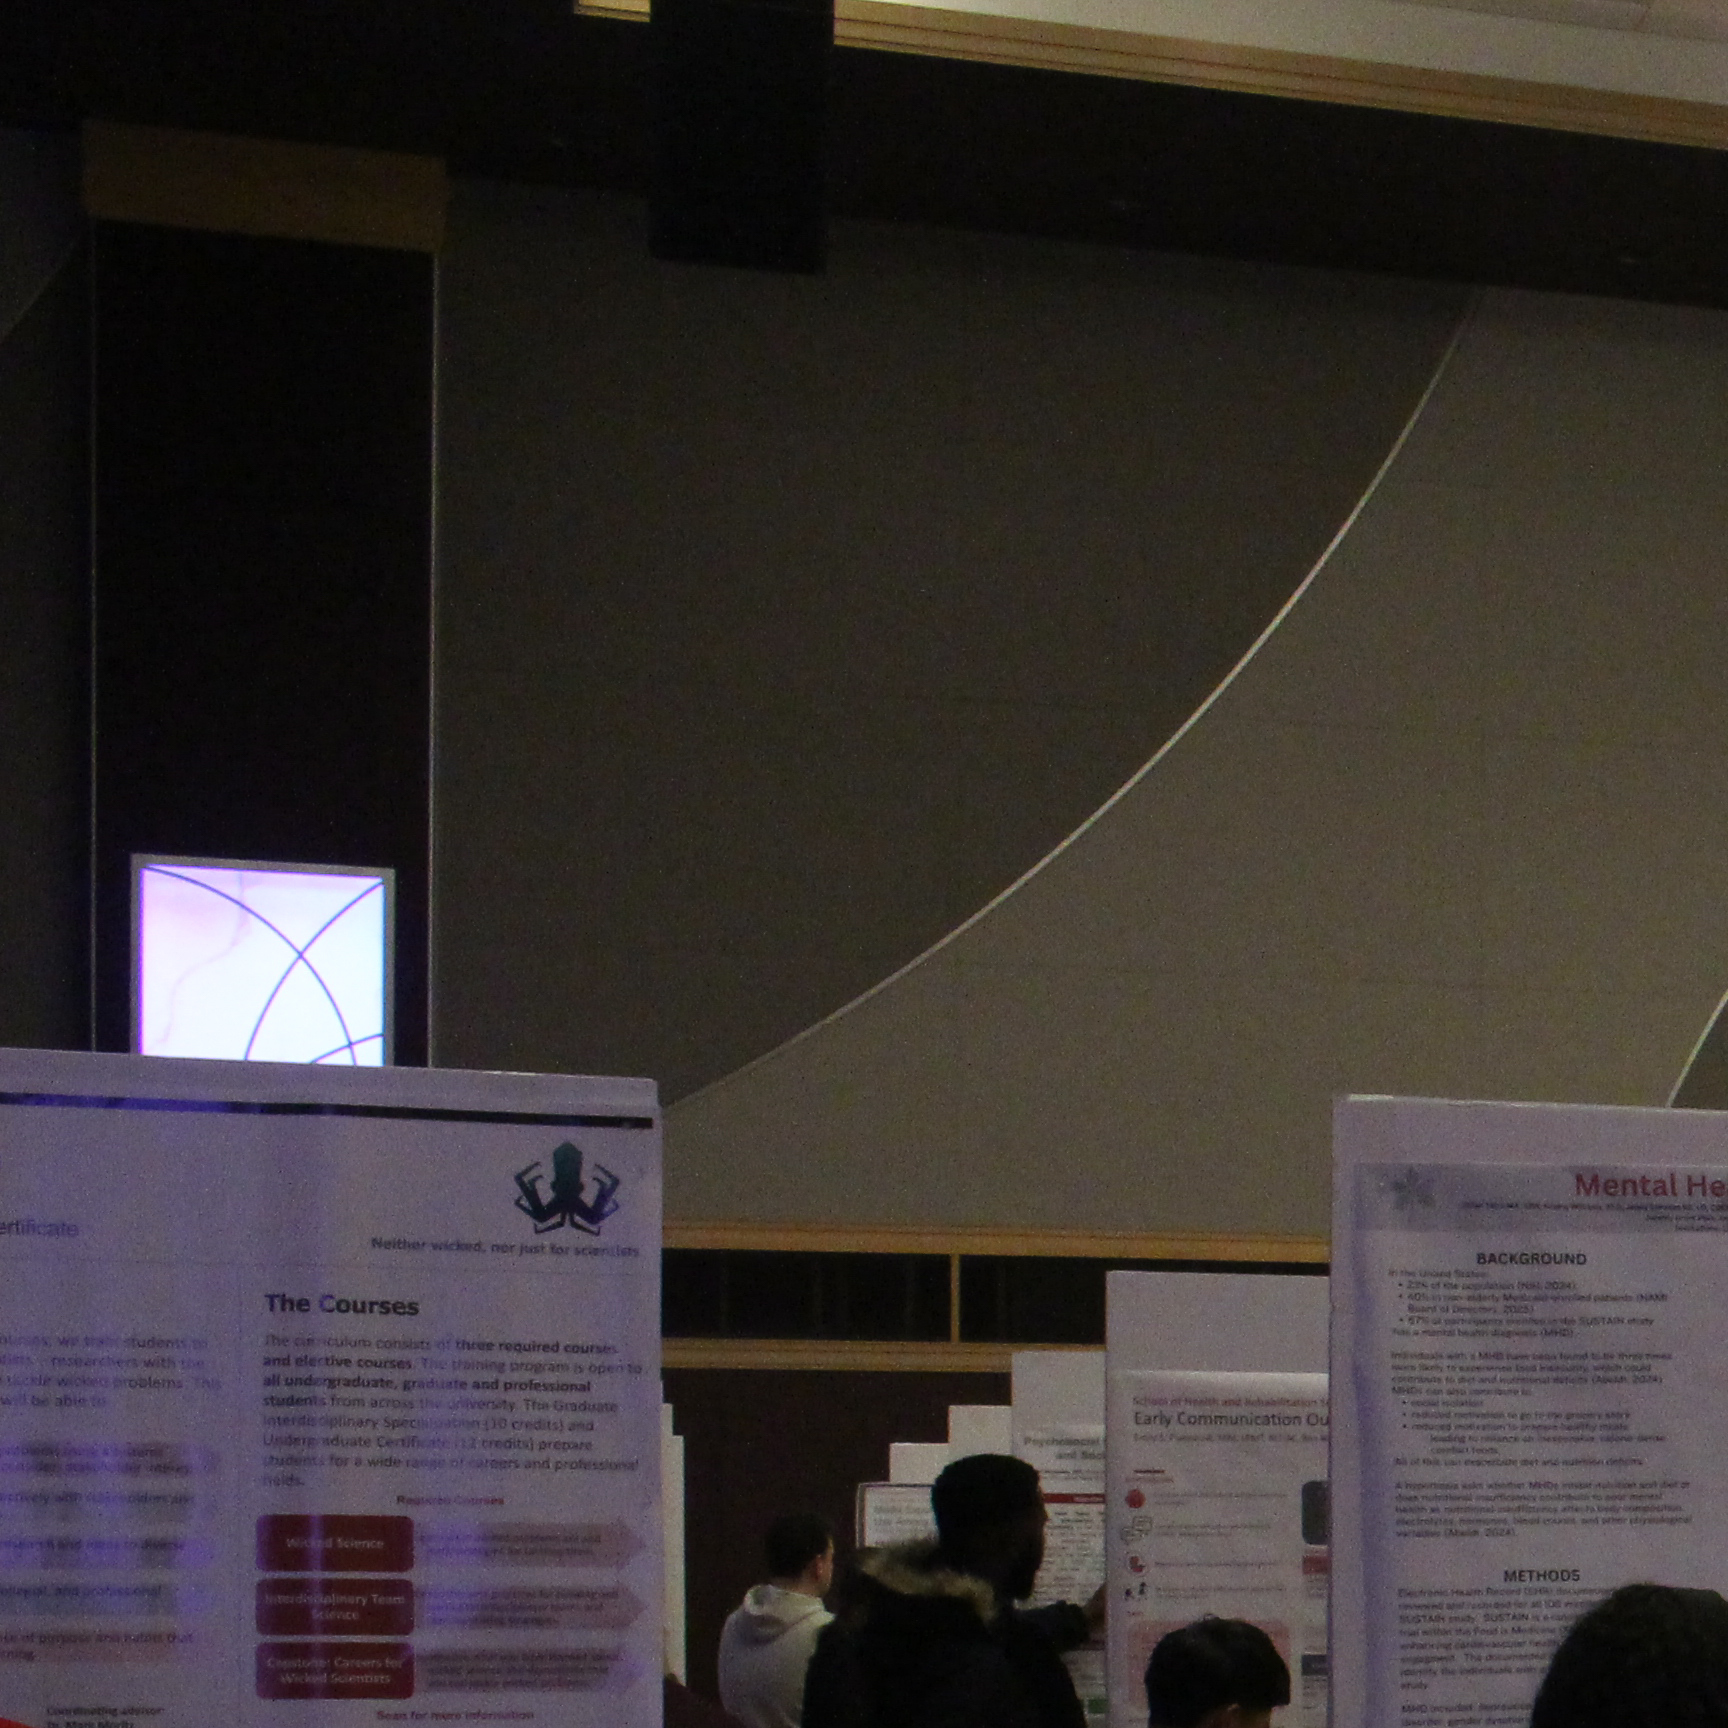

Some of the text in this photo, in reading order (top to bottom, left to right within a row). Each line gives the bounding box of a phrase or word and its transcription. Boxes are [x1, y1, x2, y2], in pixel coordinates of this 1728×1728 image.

[1575, 1173, 1677, 1198] Mental
[0, 1219, 79, 1237] ertificate
[1476, 1253, 1587, 1266] BACKGROUND
[264, 1293, 420, 1316] The Courses
[1135, 1411, 1171, 1428] Early
[1177, 1411, 1301, 1427] Communication
[1504, 1569, 1581, 1582] METHODS
